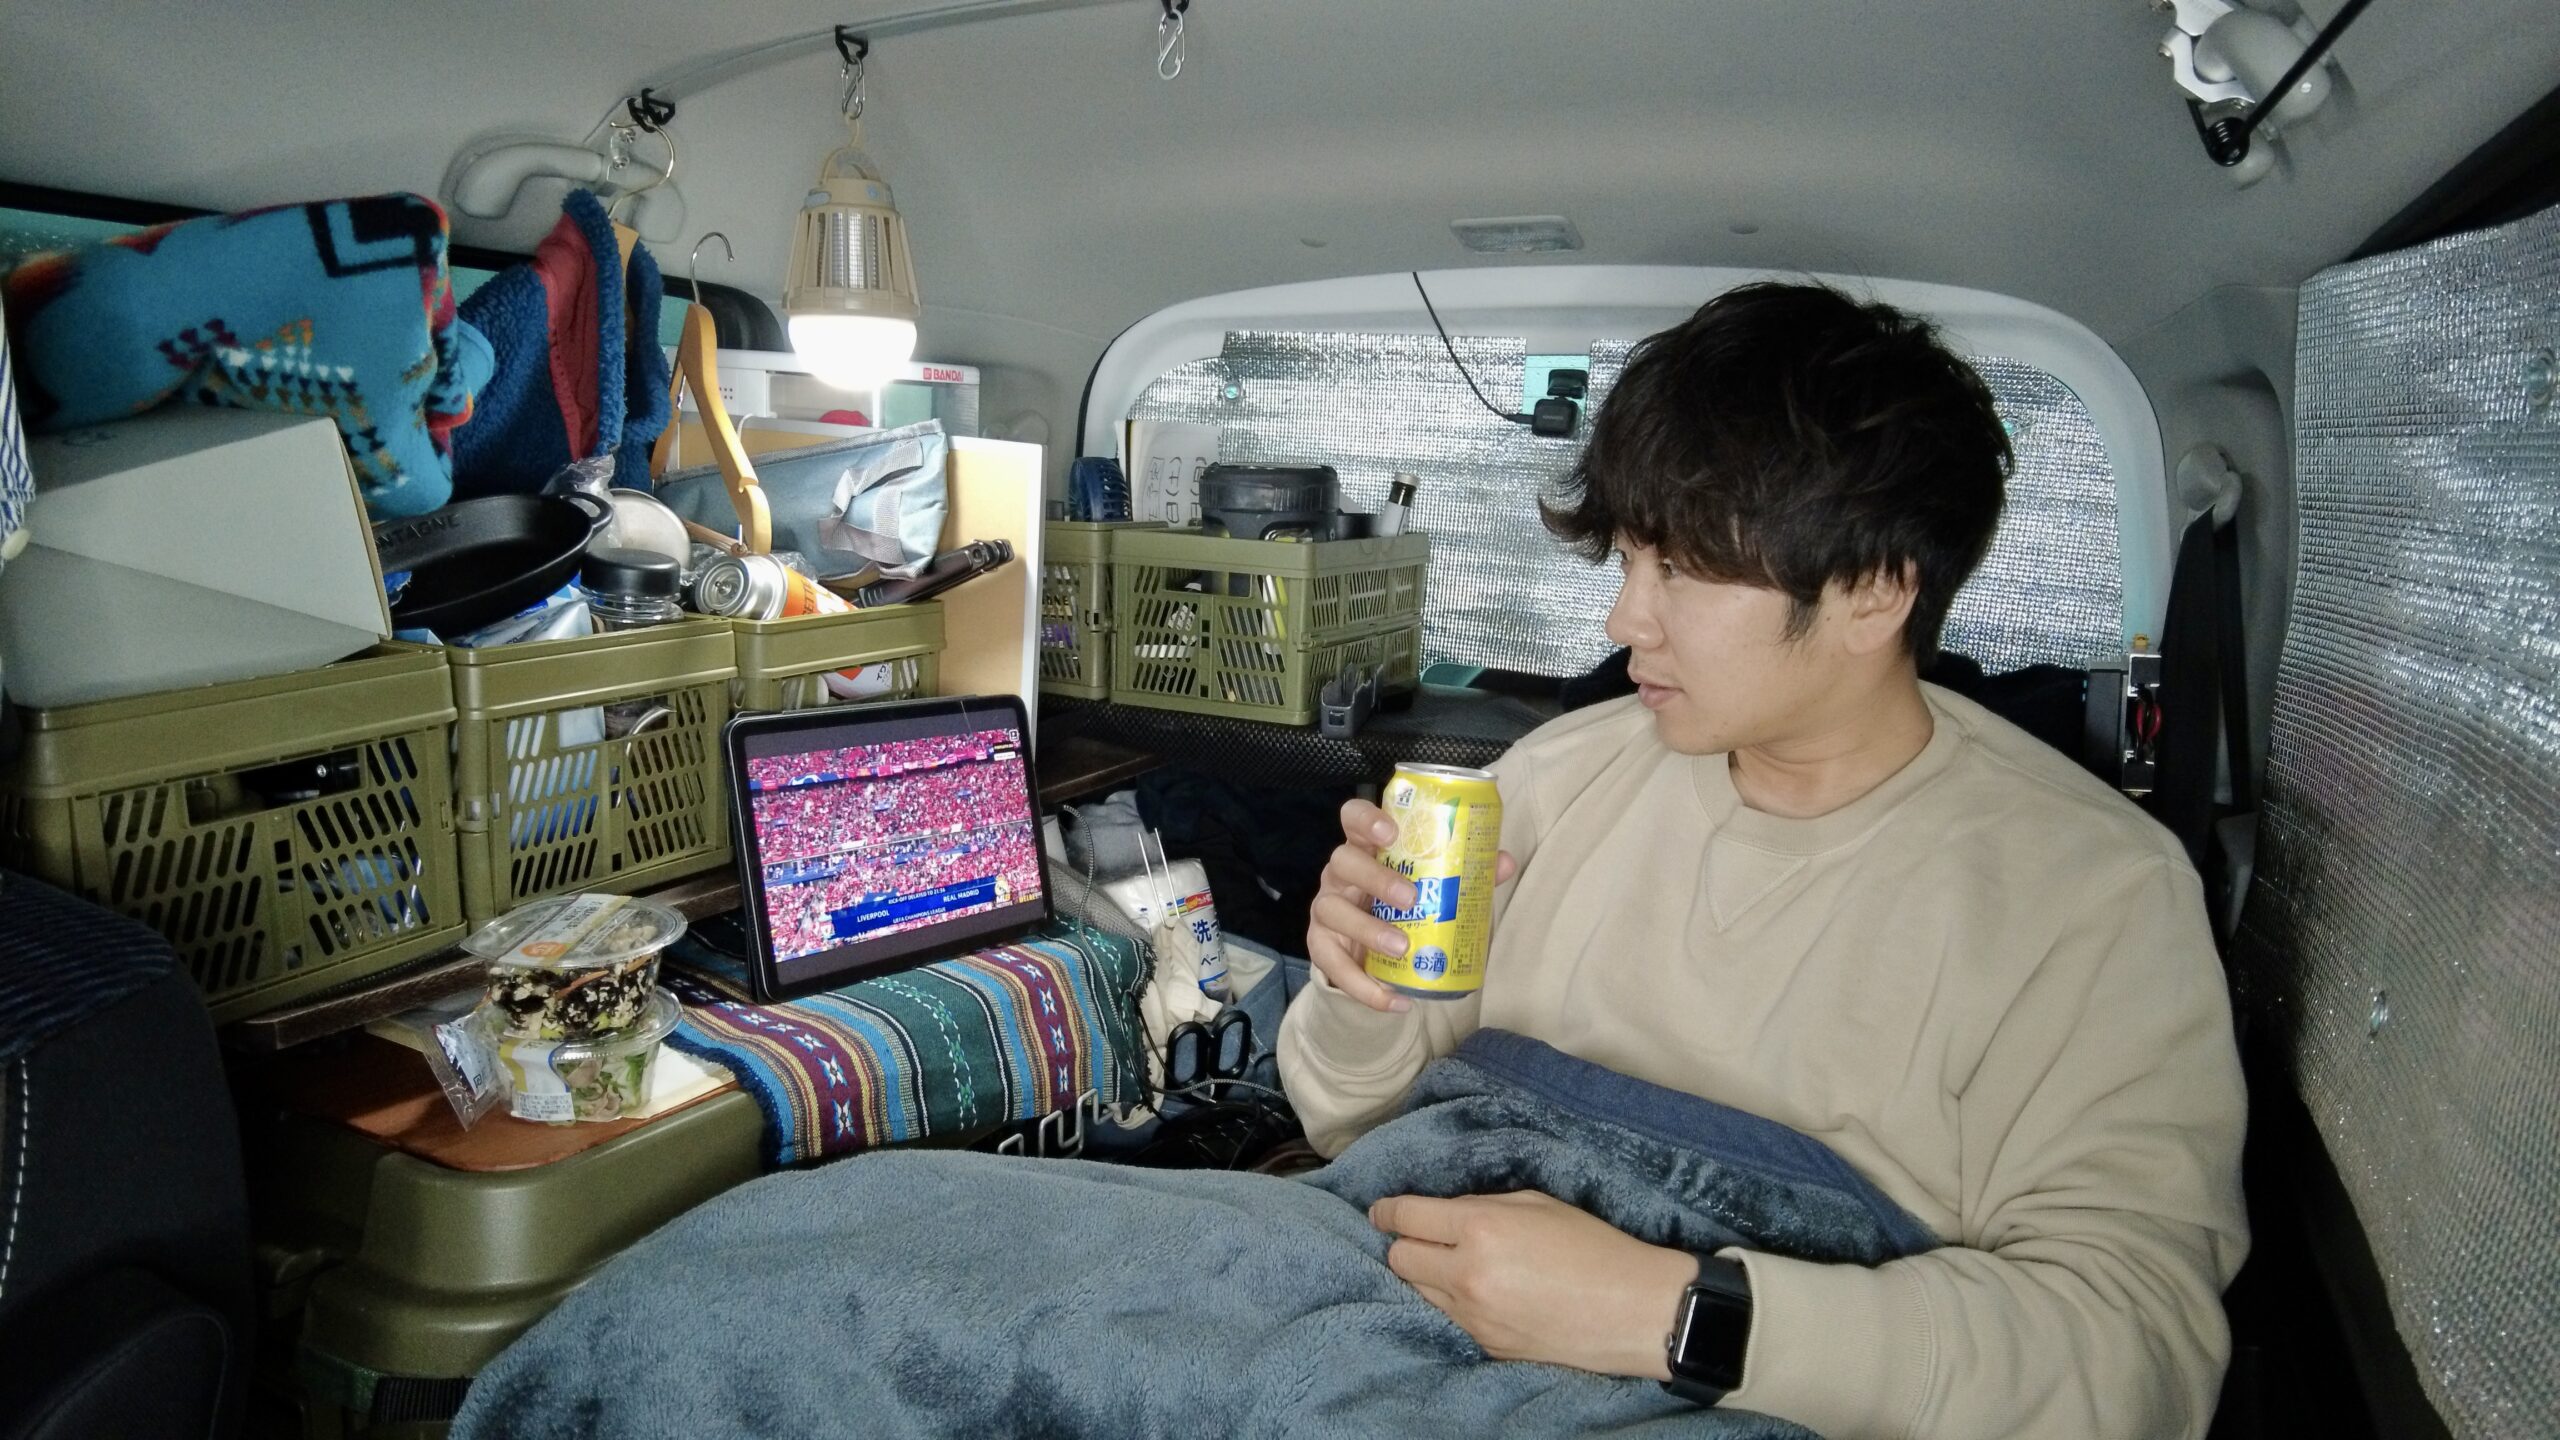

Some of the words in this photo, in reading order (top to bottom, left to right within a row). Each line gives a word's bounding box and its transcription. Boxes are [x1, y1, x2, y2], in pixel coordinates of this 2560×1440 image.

[933, 368, 964, 382] BANDAI
[943, 894, 957, 903] REAL
[957, 889, 980, 901] MADRID
[857, 909, 890, 923] LIVERPOOL
[903, 910, 929, 922] CHAMPIONS
[929, 906, 946, 917] LEAGUE
[1414, 955, 1447, 973] お酒
